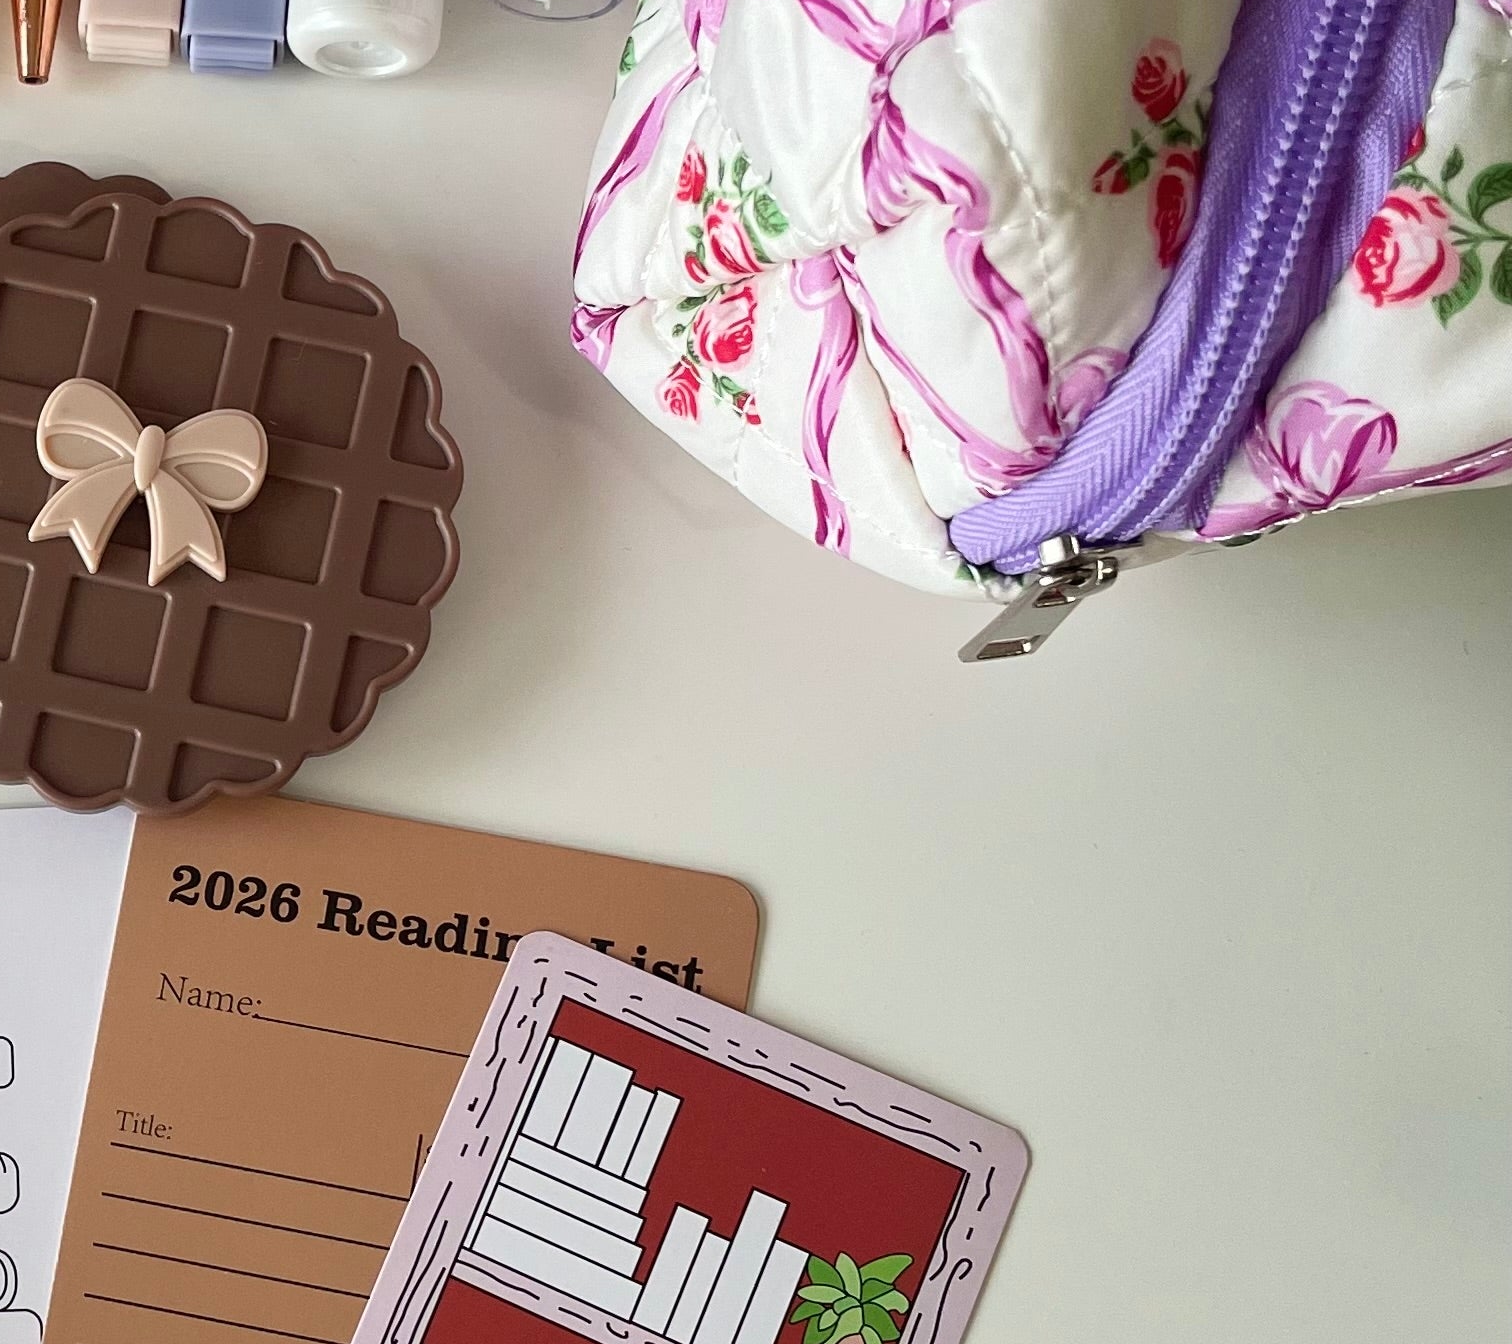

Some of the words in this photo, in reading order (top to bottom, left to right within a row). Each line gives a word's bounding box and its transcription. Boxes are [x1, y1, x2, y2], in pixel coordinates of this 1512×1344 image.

[168, 864, 302, 923] 2026
[316, 889, 524, 963] Readin
[590, 937, 704, 995] ist
[155, 972, 263, 1019] Name:
[115, 1109, 173, 1140] Title:
